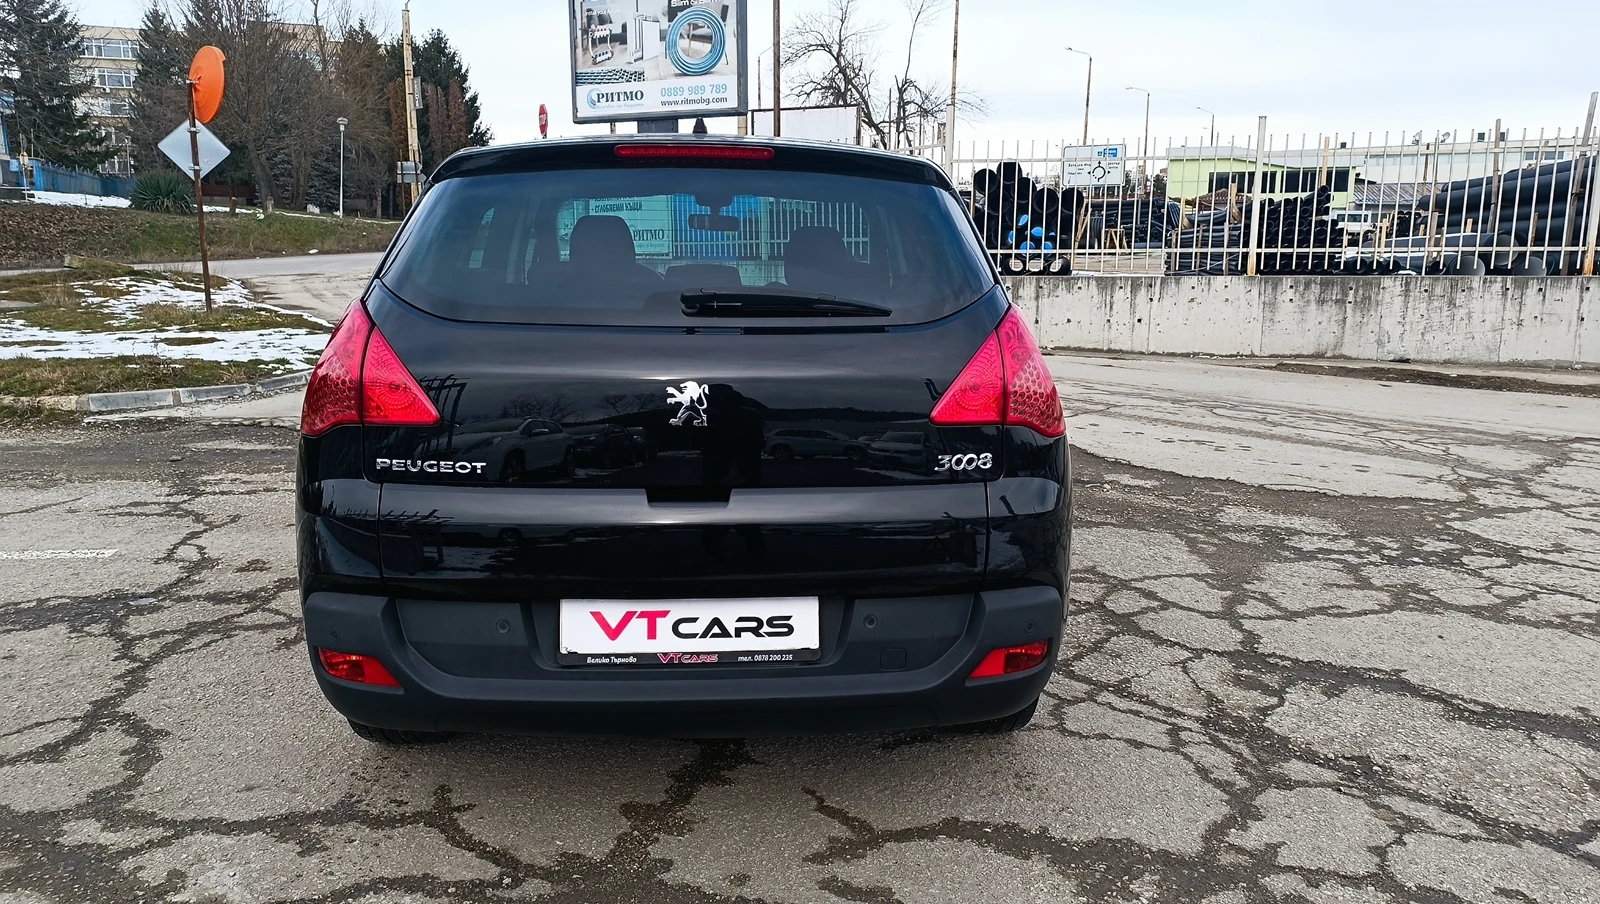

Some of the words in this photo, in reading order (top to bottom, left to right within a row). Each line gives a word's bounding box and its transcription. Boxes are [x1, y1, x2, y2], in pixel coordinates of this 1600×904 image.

[596, 89, 645, 104] РИТМО
[661, 86, 685, 97] 0889
[687, 84, 706, 96] 989
[709, 83, 728, 94] 789
[660, 96, 728, 106] www.ritmobg.com
[632, 229, 665, 241] РИТМО
[376, 458, 487, 473] PEUGEOT
[934, 452, 993, 471] 3008
[589, 610, 671, 641] VT
[671, 615, 795, 639] CARS
[587, 656, 610, 664] Велико
[611, 656, 637, 665] Търново
[681, 654, 718, 663] CARS
